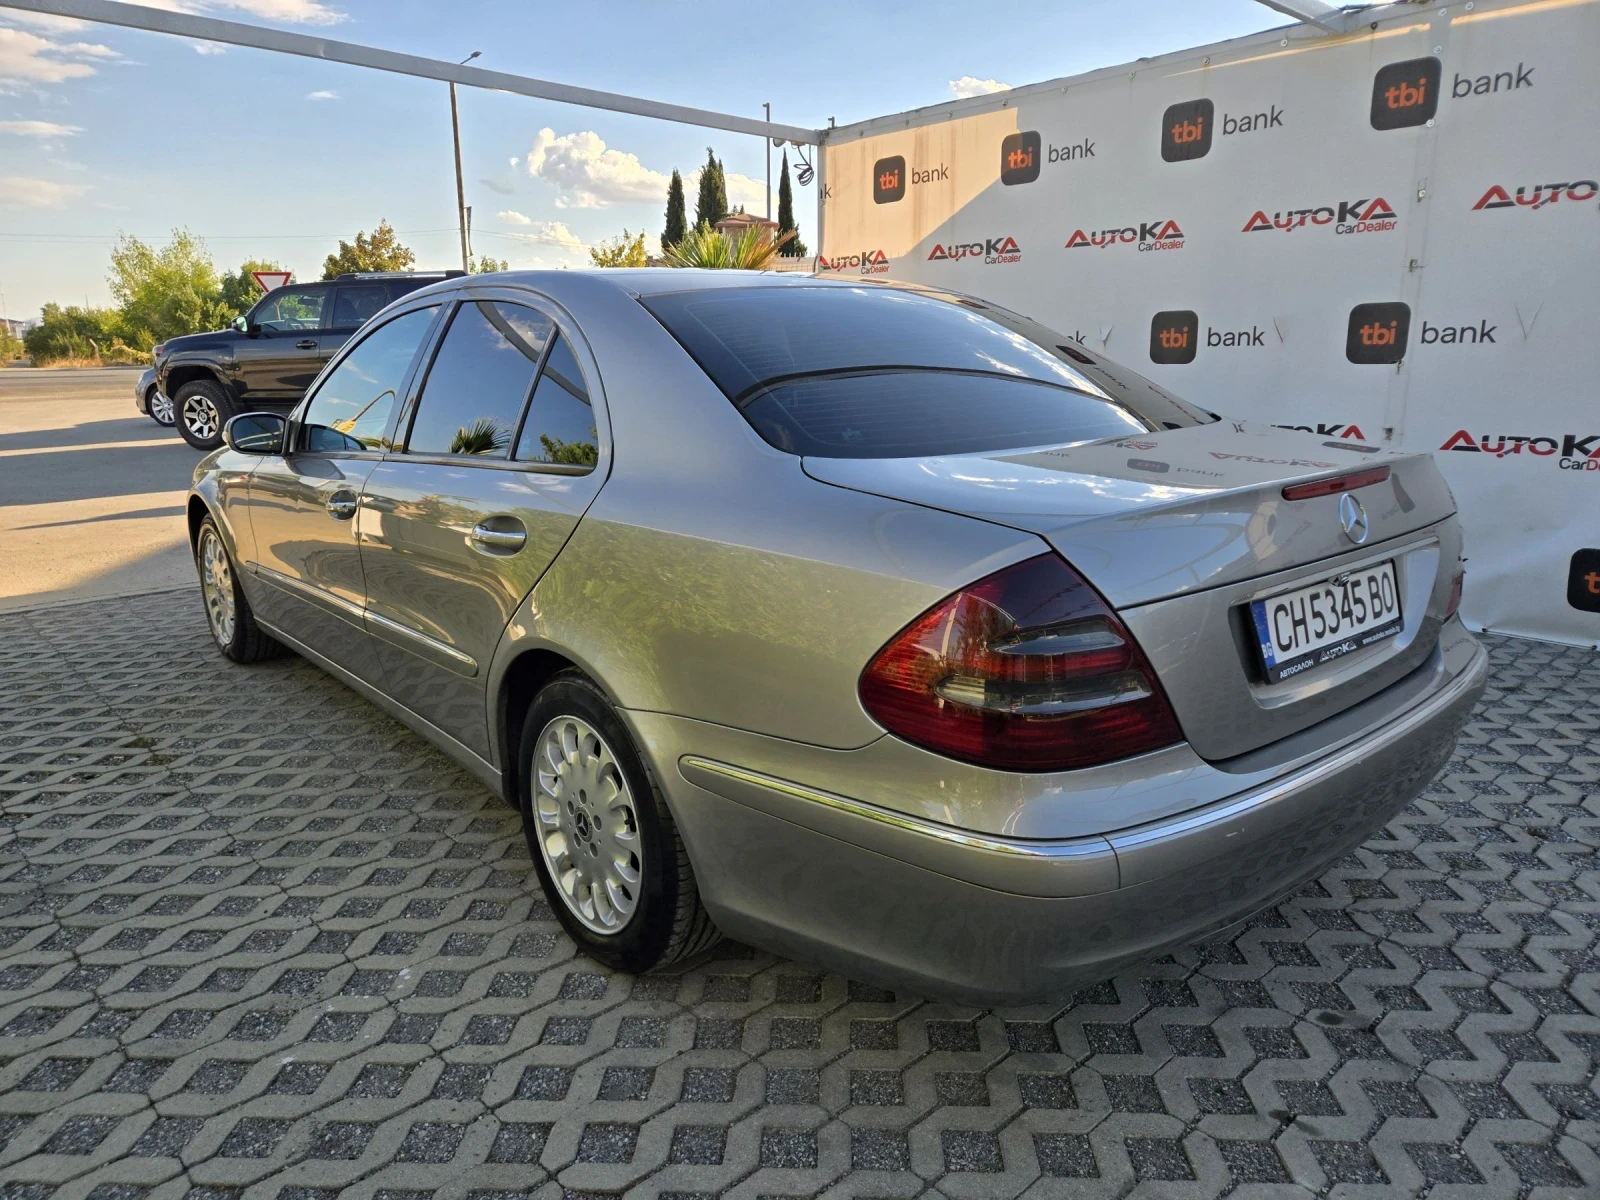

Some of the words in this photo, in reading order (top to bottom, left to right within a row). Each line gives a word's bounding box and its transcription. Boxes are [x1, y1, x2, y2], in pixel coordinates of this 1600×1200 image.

[1385, 77, 1428, 109] tbi
[1452, 62, 1536, 99] bank
[1171, 117, 1204, 144] tbi
[1222, 104, 1285, 136] bank
[1008, 146, 1033, 170] tbi
[1048, 138, 1096, 163] bank
[879, 169, 899, 191] tbi
[911, 163, 949, 185] bank
[1335, 220, 1398, 235] CarDealer
[1138, 239, 1185, 252] CarDealer
[861, 264, 890, 275] CarDealer
[984, 253, 1022, 265] CarDealer
[1160, 326, 1189, 348] tbi
[1207, 325, 1266, 347] bank
[1359, 320, 1398, 346] tbi
[1420, 319, 1498, 344] bank
[1439, 429, 1600, 458] AUTOK
[1559, 457, 1600, 471] CarD
[1261, 643, 1273, 659] BG
